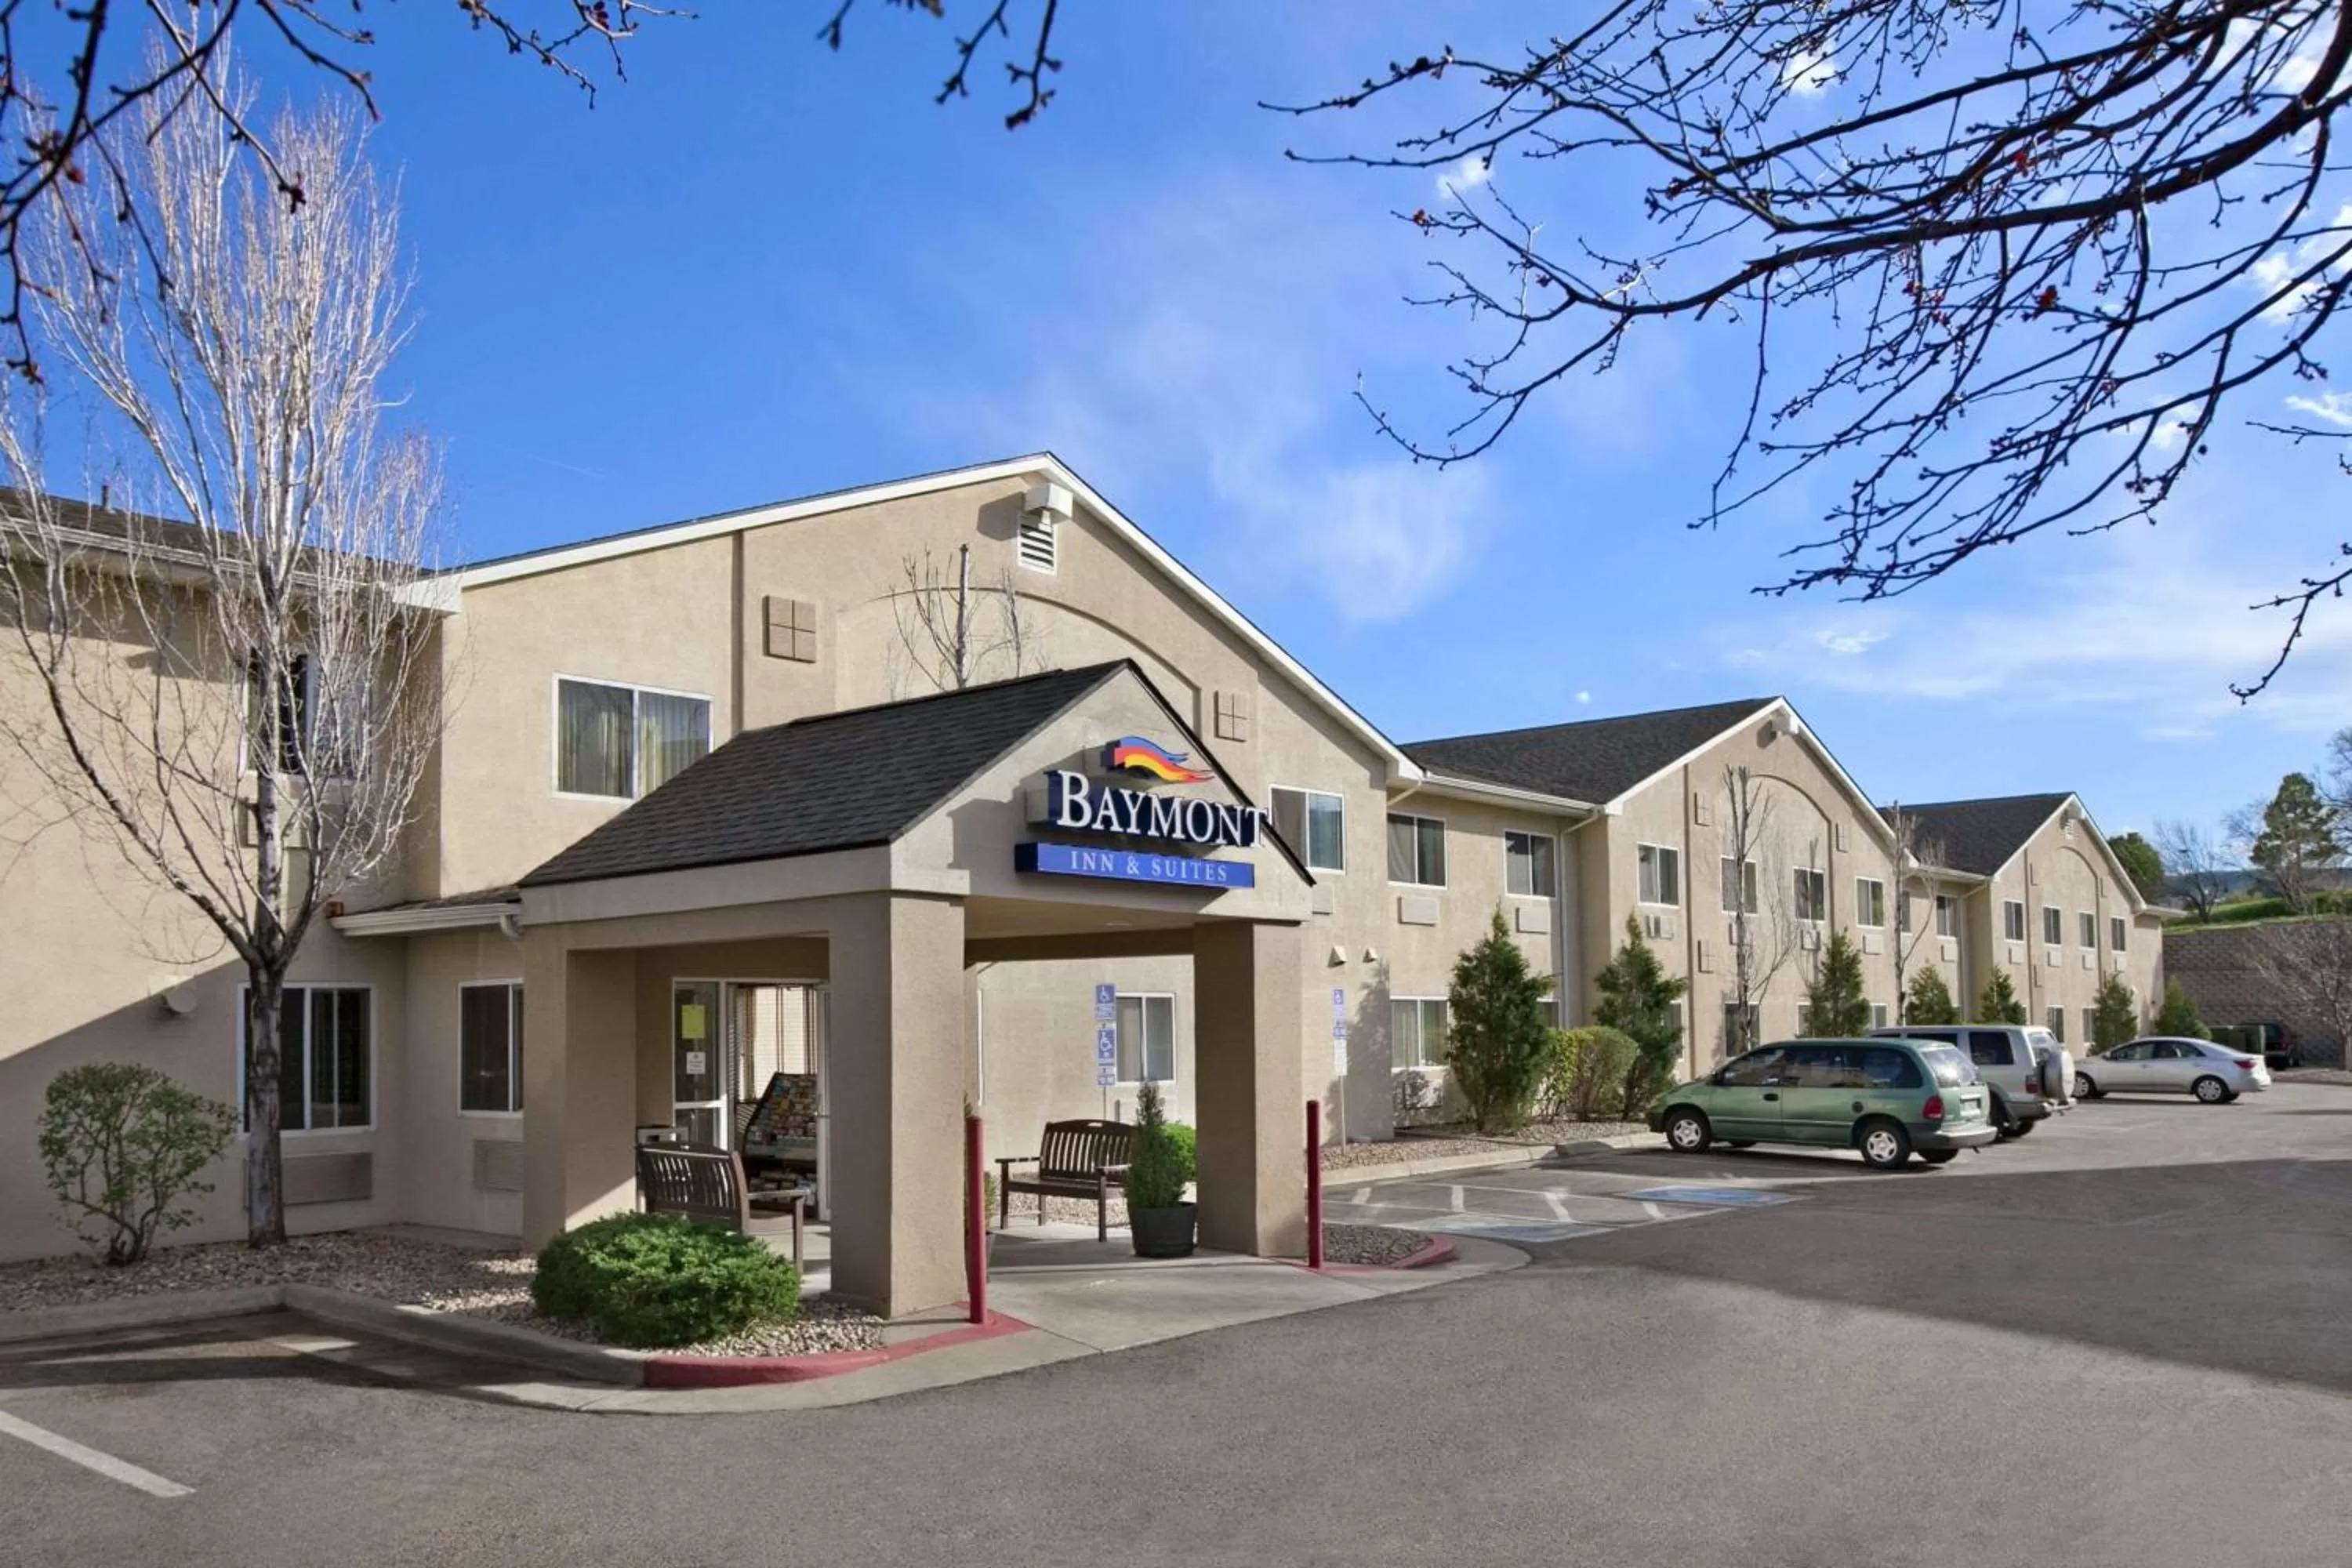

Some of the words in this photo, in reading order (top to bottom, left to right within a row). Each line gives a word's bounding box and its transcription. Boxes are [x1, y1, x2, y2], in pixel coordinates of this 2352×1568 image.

[1056, 769, 1268, 848] BAYMONT
[1070, 851, 1115, 873] INN
[1127, 855, 1139, 876] &
[1151, 858, 1228, 882] SUITES
